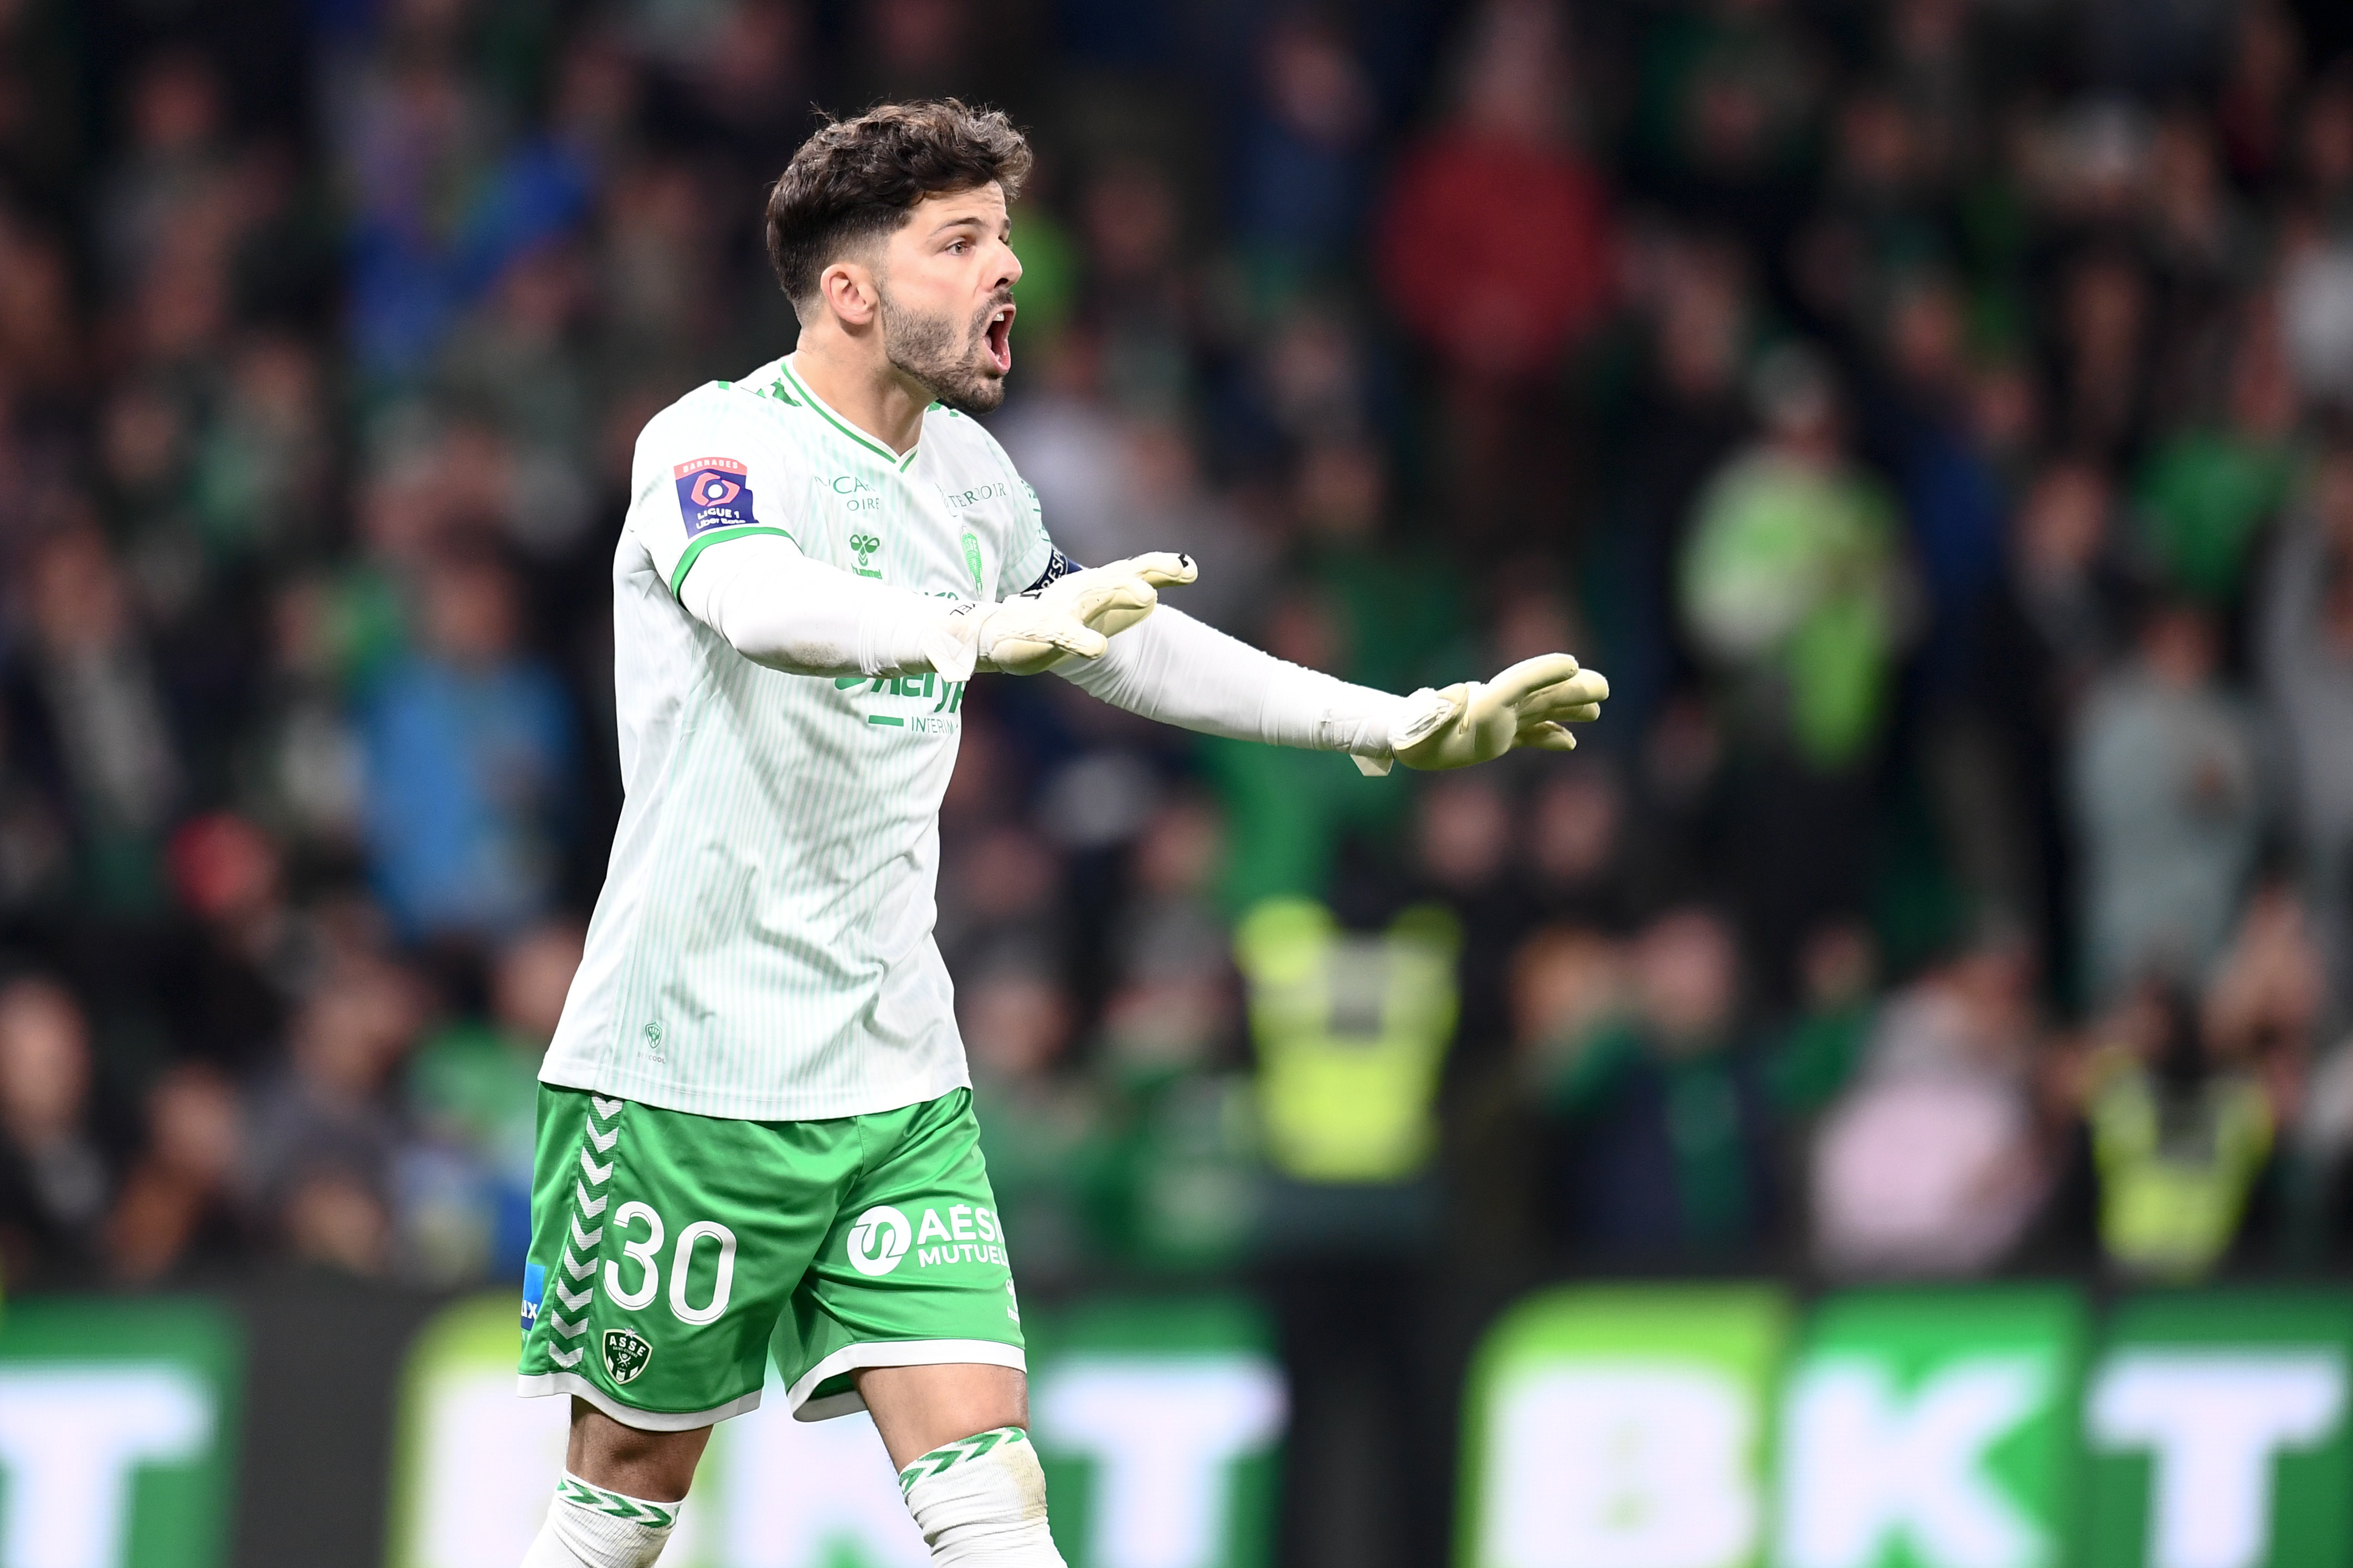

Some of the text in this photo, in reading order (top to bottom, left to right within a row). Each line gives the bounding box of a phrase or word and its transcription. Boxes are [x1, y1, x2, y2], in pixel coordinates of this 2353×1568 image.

[683, 459, 738, 473] BARRAGES
[697, 508, 740, 520] LIGUE 1
[917, 1204, 1005, 1245] AÉSI
[603, 1200, 737, 1325] 30
[609, 1335, 646, 1357] ASSE
[1490, 1356, 2348, 1568] BKT
